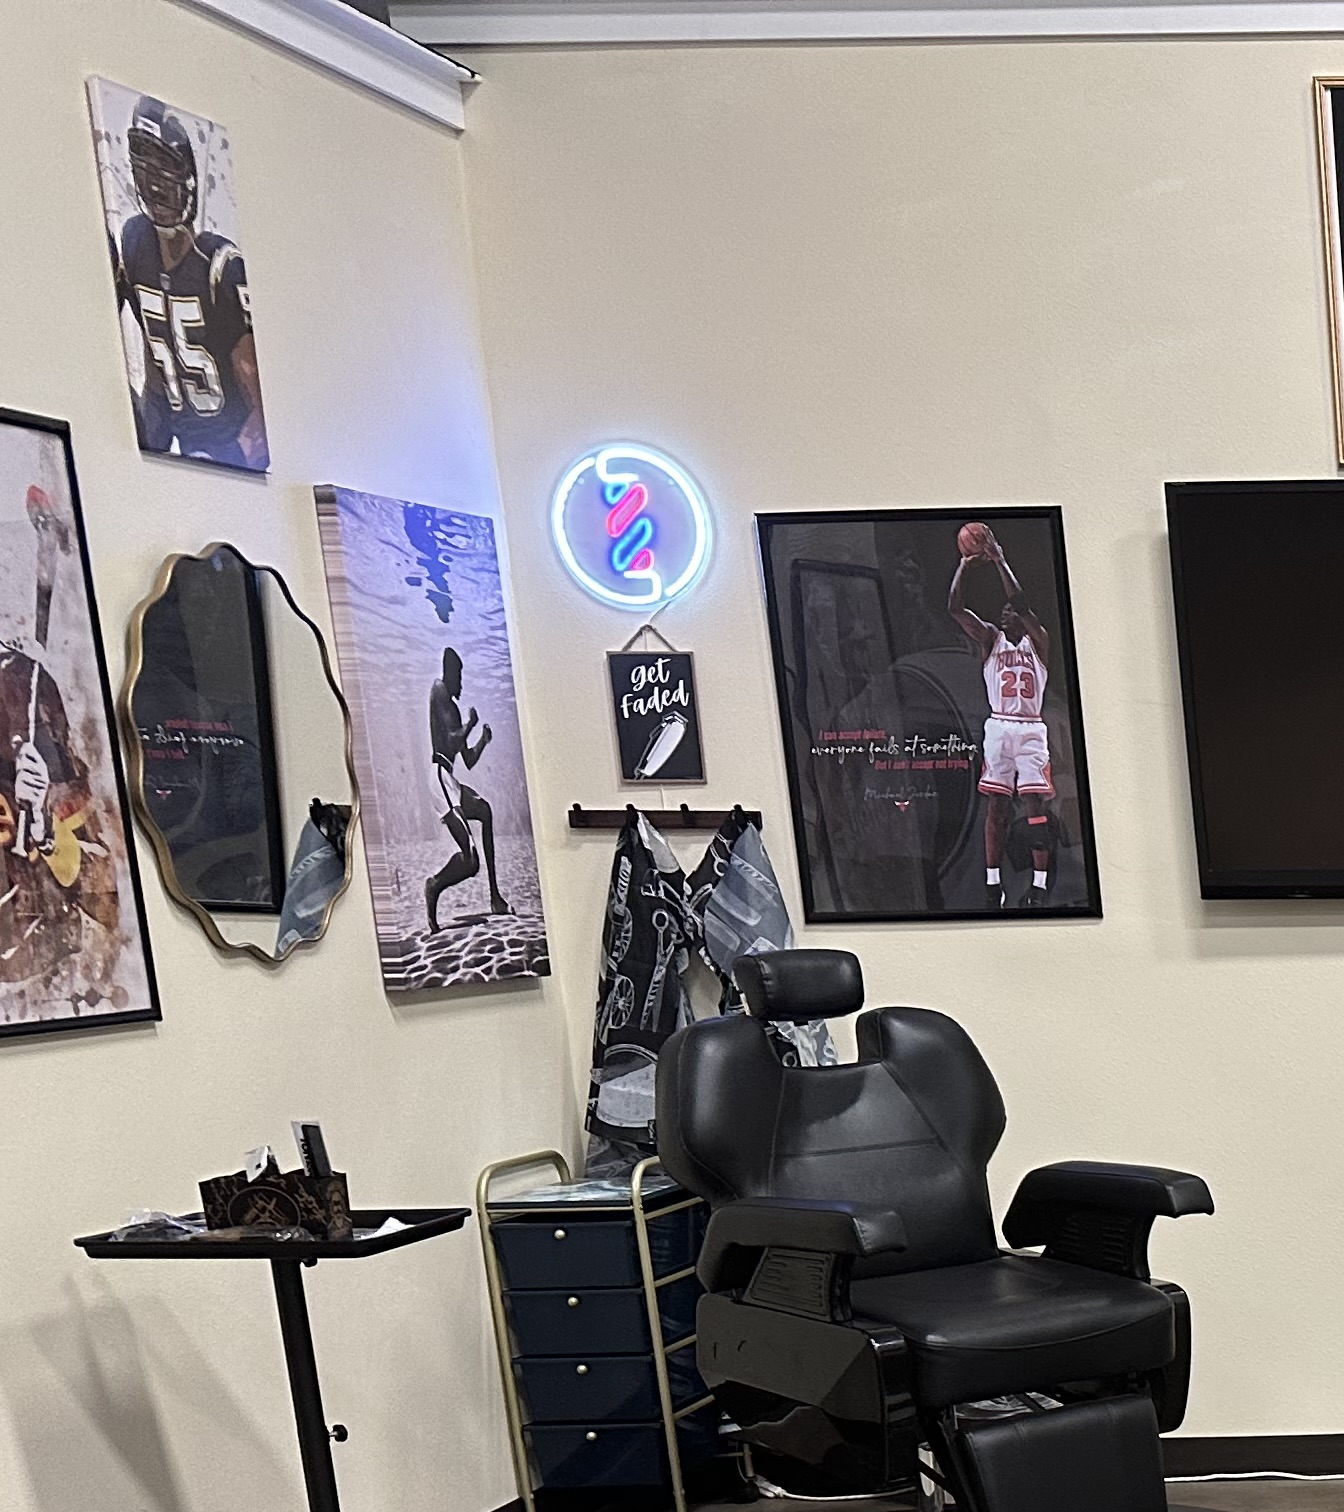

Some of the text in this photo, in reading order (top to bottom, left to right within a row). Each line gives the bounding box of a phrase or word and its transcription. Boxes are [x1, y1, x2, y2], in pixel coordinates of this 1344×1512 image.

[134, 283, 225, 417] 55
[631, 658, 671, 692] get
[1001, 671, 1035, 699] 23
